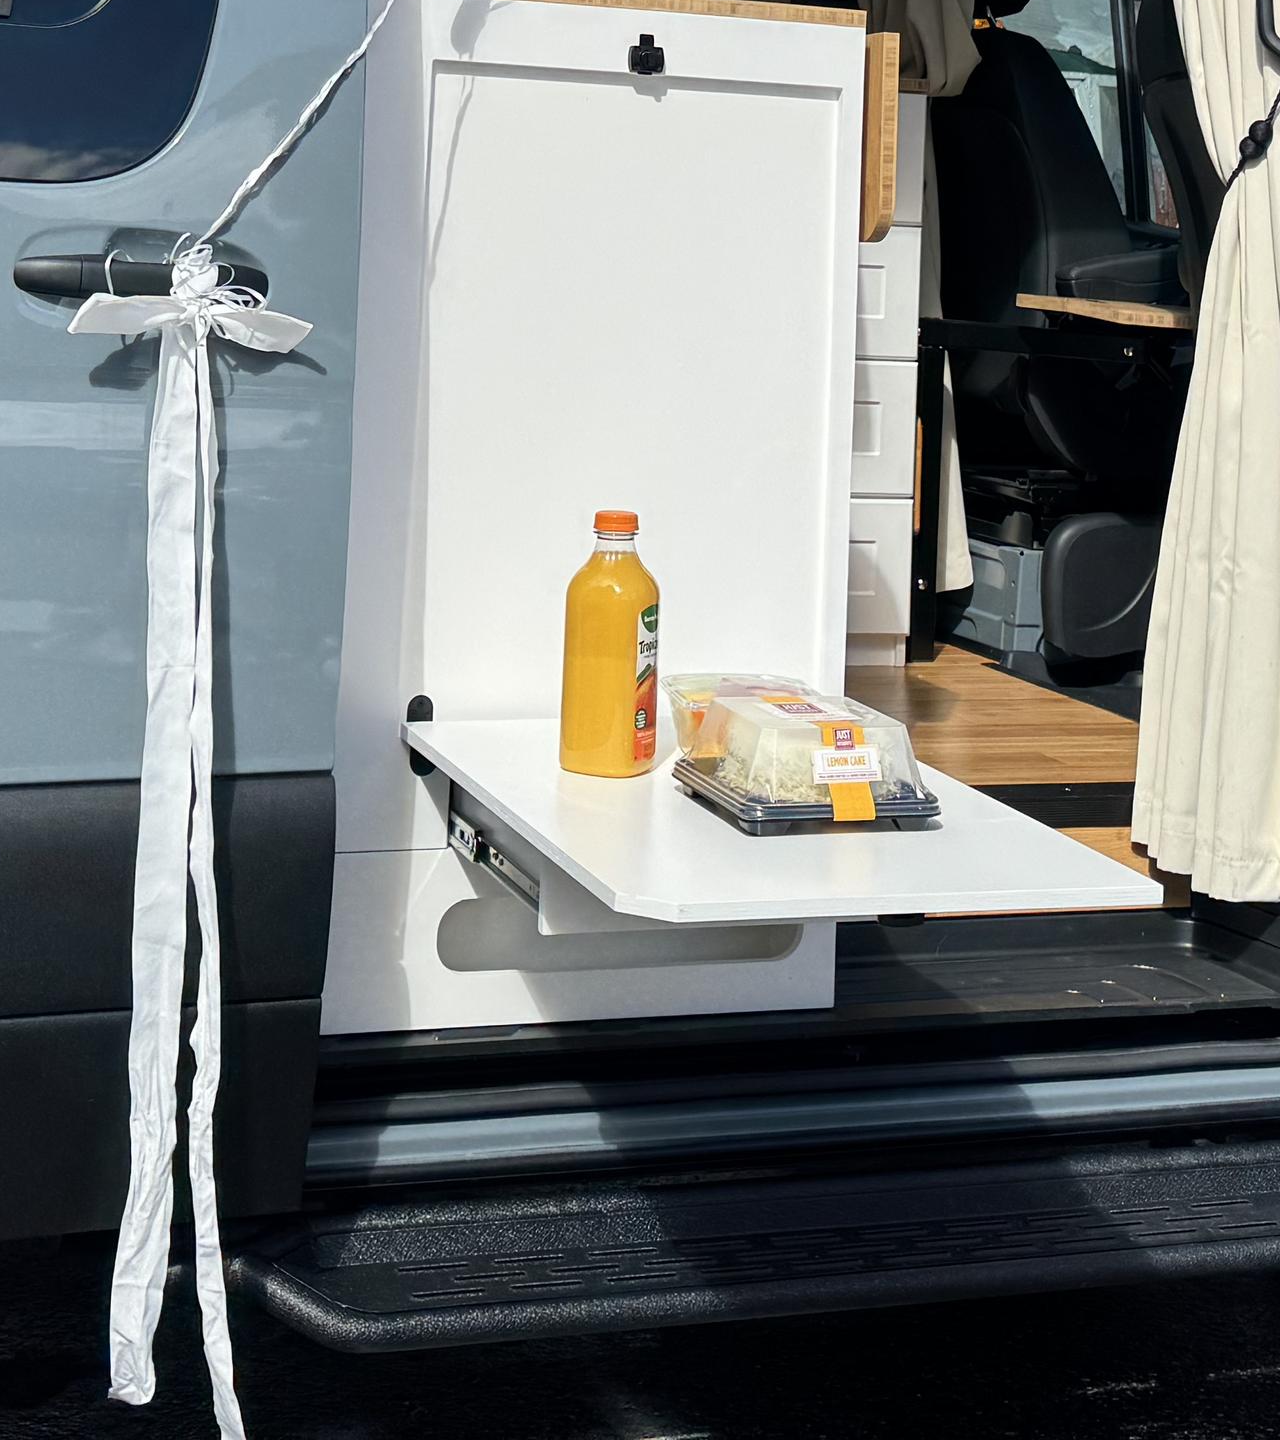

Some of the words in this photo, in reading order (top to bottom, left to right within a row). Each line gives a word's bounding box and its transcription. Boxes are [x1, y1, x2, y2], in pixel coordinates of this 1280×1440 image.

[836, 729, 851, 740] JUST
[827, 756, 849, 767] LEMON
[850, 755, 866, 766] CAKE
